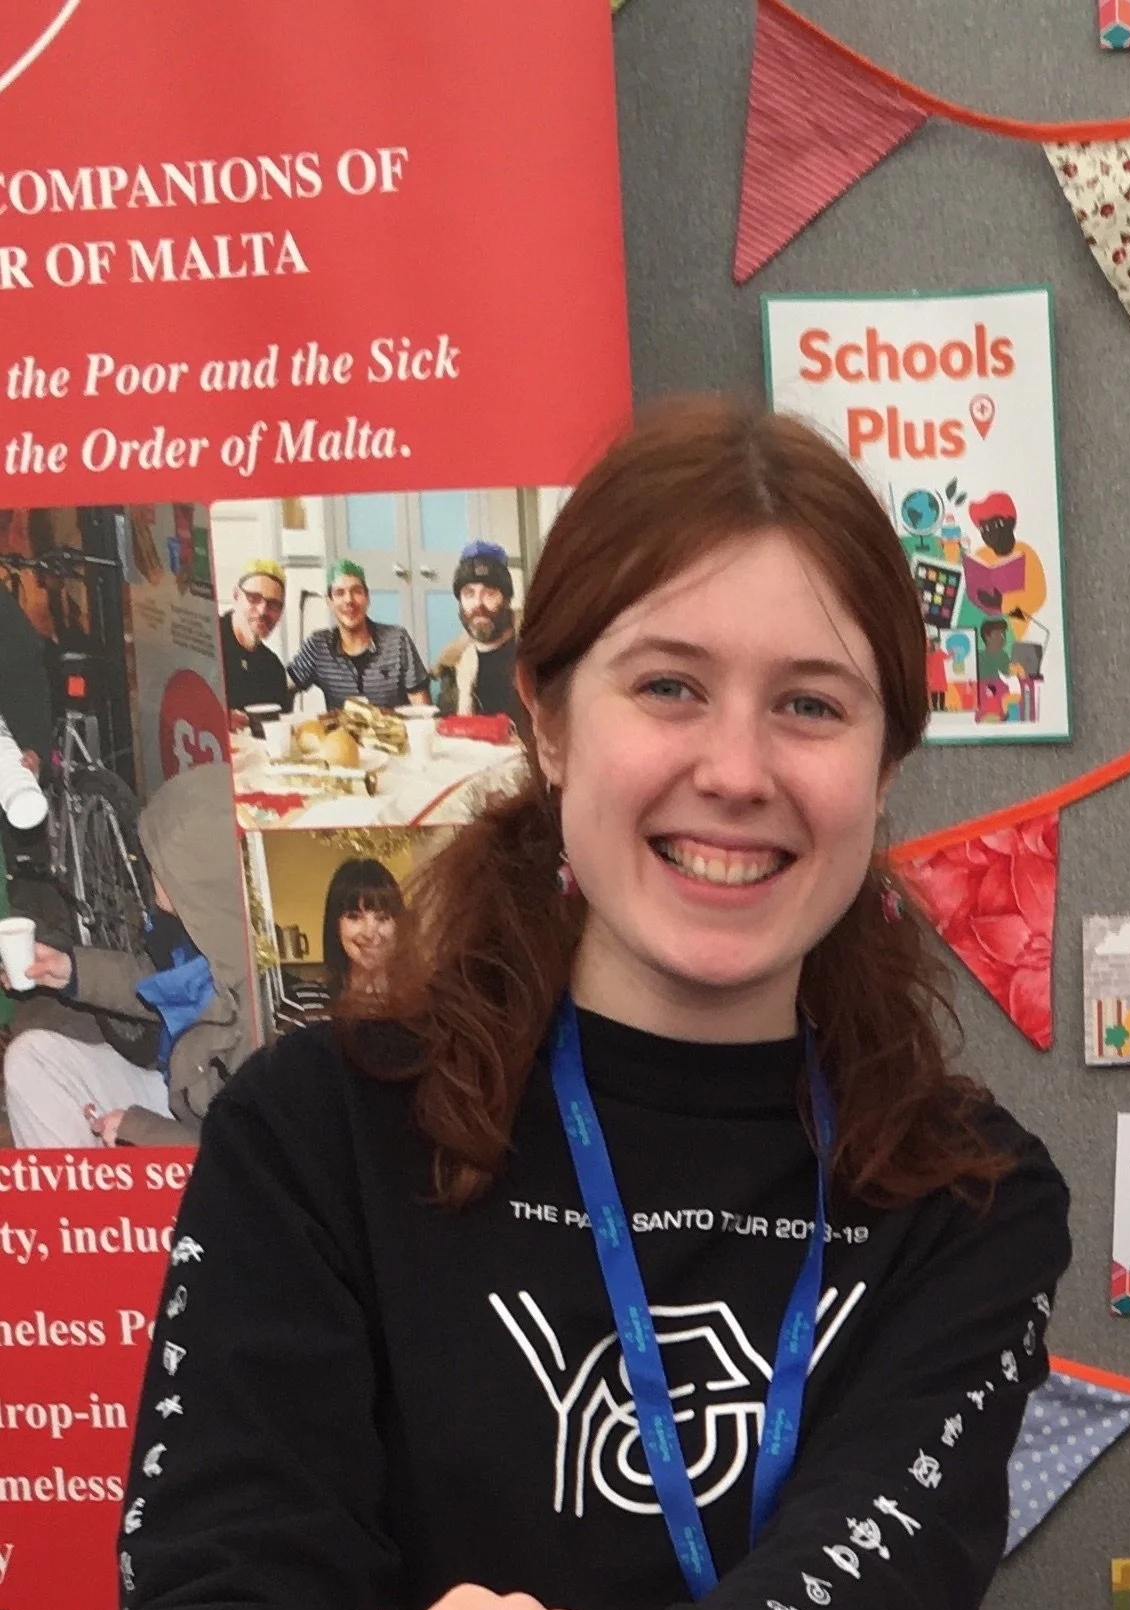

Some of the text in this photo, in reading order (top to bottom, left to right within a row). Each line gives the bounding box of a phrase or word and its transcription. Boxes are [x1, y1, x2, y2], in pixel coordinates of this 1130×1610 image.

[337, 147, 408, 195] OF
[45, 240, 117, 287] OF
[129, 230, 310, 284] MALTA
[6, 334, 461, 400] the Poor and the Sick
[799, 321, 1016, 384] Schools
[4, 416, 412, 477] the Order of Malta.
[846, 405, 968, 462] Plus
[509, 1200, 558, 1223] THE
[631, 1208, 715, 1233] SANTO
[0, 1392, 128, 1439] rop-in
